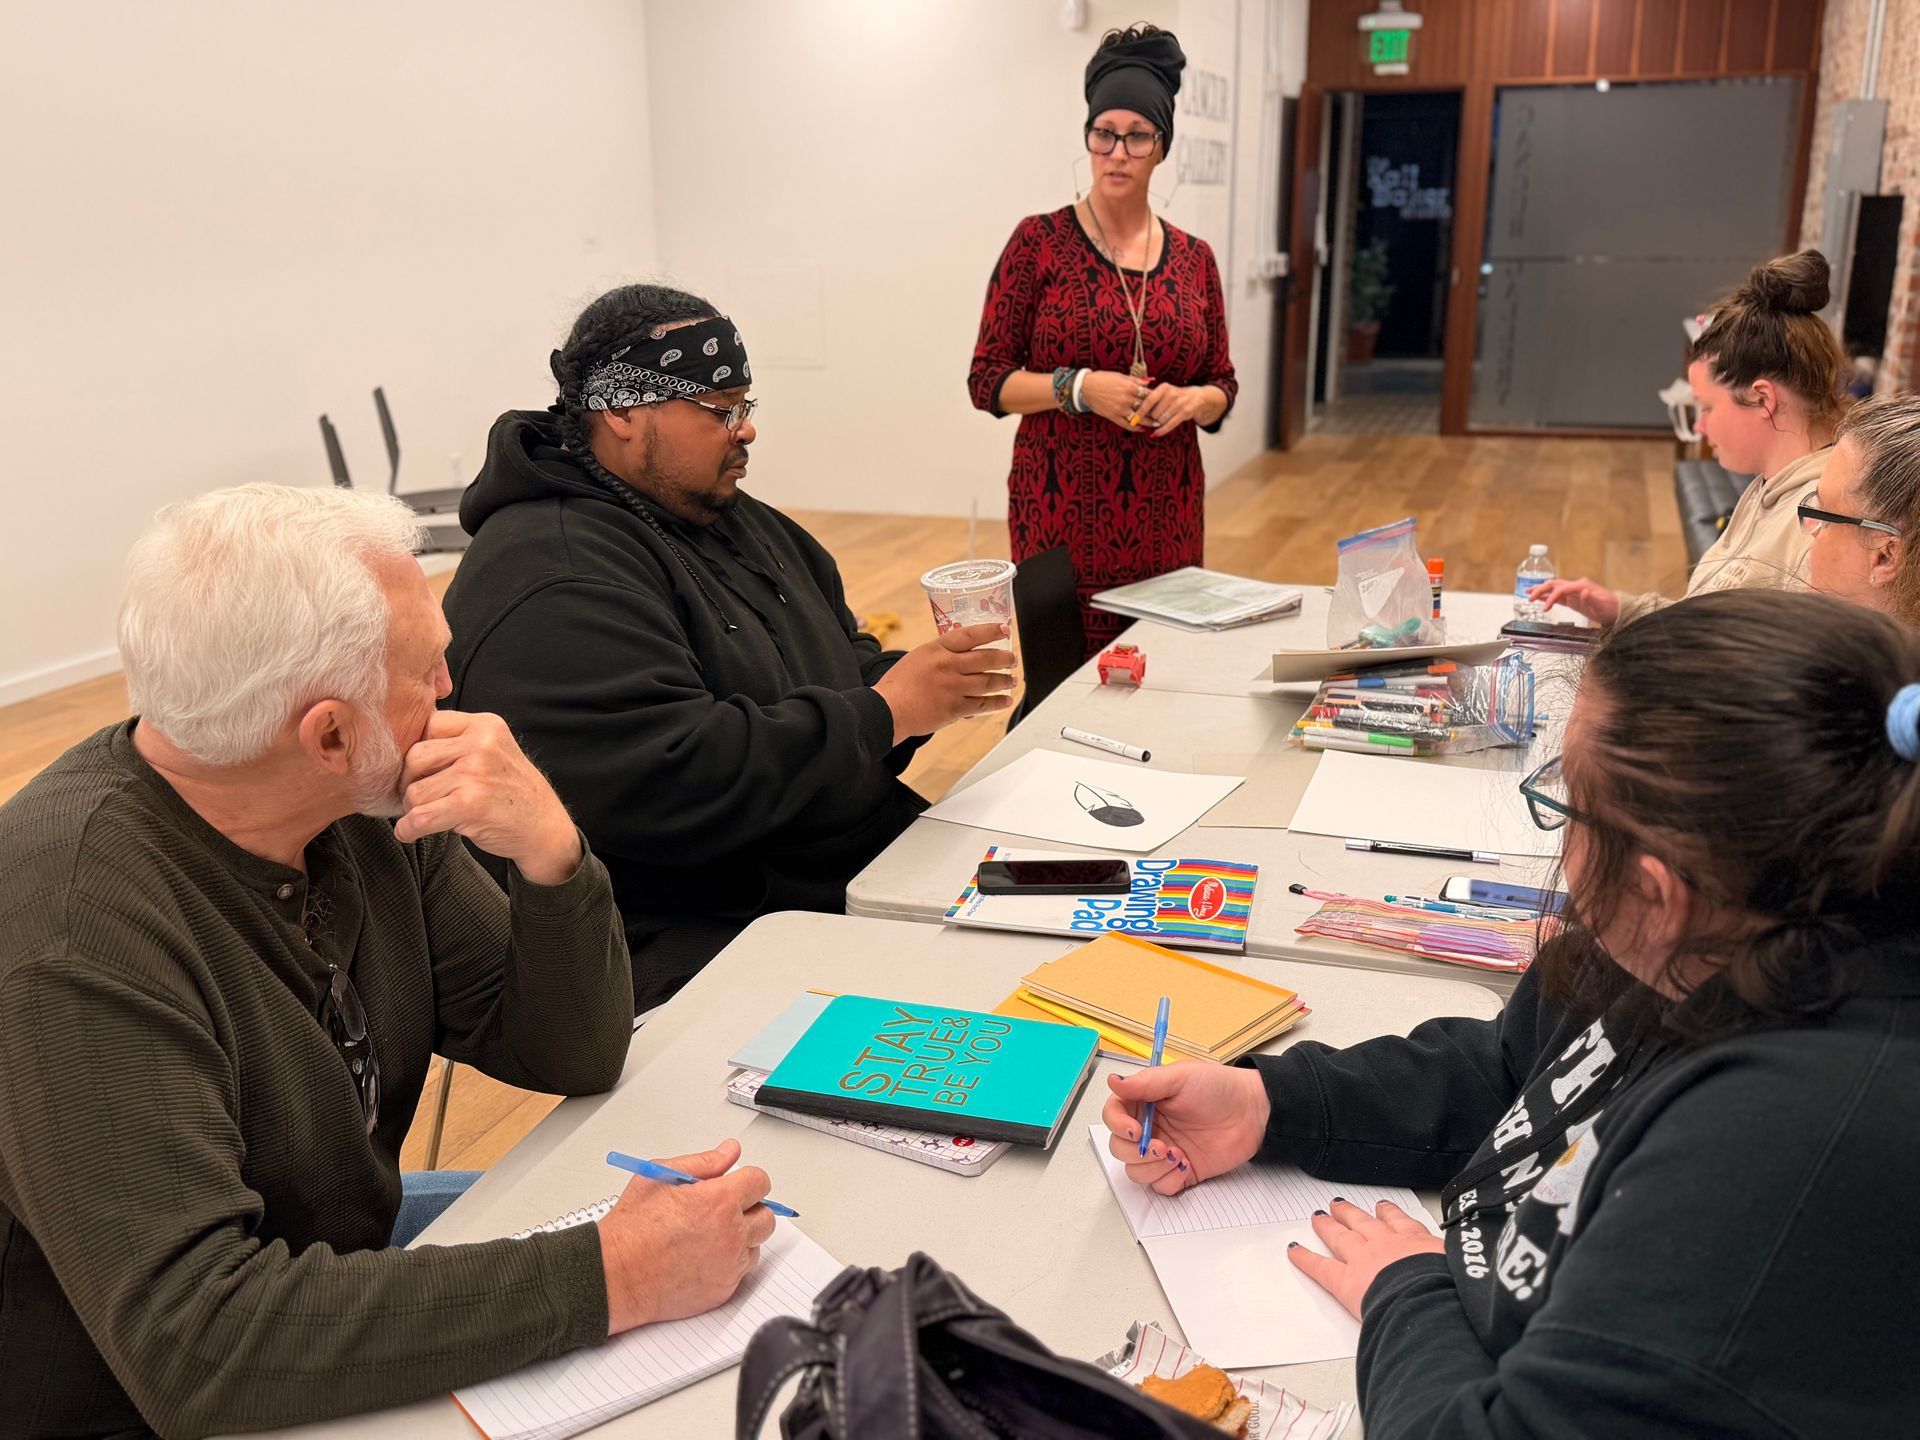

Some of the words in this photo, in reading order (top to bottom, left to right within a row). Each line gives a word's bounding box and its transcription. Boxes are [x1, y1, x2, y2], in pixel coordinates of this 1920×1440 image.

[1371, 30, 1408, 61] EXIT
[1070, 898, 1122, 932] Pad
[1106, 859, 1178, 932] Drawing
[839, 1006, 933, 1095] STAY
[933, 1073, 980, 1106] BE
[957, 1019, 1012, 1065] YOU
[1460, 1227, 1490, 1279] 2016
